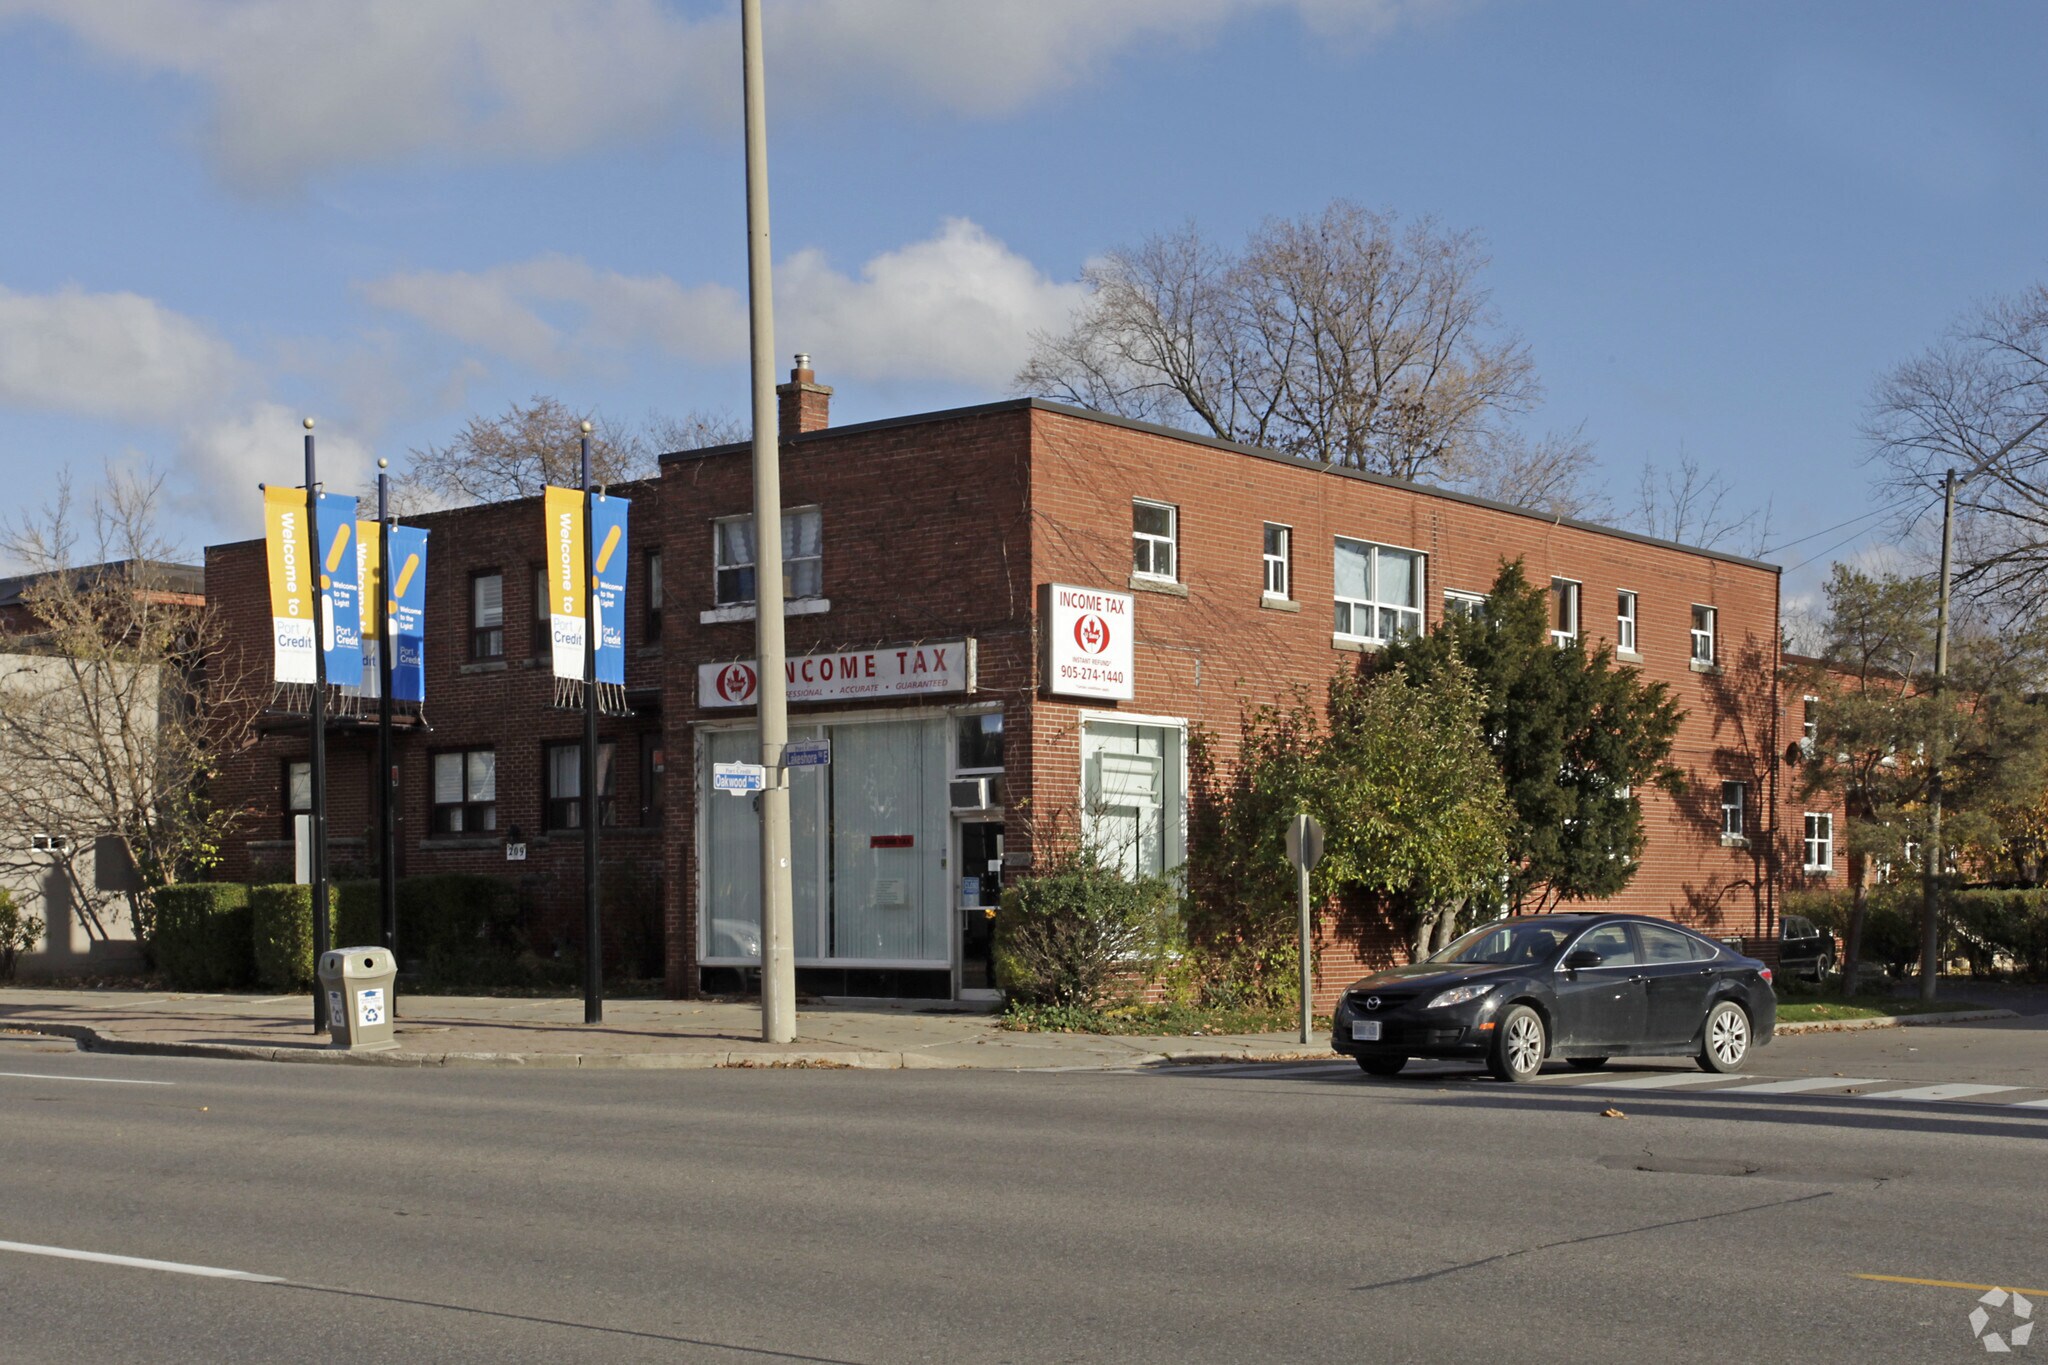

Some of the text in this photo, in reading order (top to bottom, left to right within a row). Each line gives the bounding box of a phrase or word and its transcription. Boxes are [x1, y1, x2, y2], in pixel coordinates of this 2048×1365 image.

[281, 512, 299, 616] Welcome to
[560, 513, 574, 613] Welcome to
[333, 581, 357, 591] Welcome
[600, 581, 623, 591] Welcome
[400, 605, 422, 615] Welcome
[1060, 592, 1125, 614] INCOME TAX
[277, 620, 300, 634] Port
[336, 625, 351, 636] Port
[554, 618, 573, 631] Port
[278, 631, 312, 648] Credit
[336, 631, 358, 646] Credit
[554, 630, 582, 645] Credit
[400, 646, 413, 656] Port
[785, 648, 948, 683] NCOME TAX
[1061, 665, 1124, 684] 905-274-1440
[840, 684, 879, 694] ACCURATE
[895, 679, 948, 690] GUARANTEED
[787, 751, 817, 765] Lakeshore
[824, 750, 828, 763] E
[716, 774, 747, 788] Oakwood
[755, 776, 761, 788] S
[508, 847, 525, 857] 209
